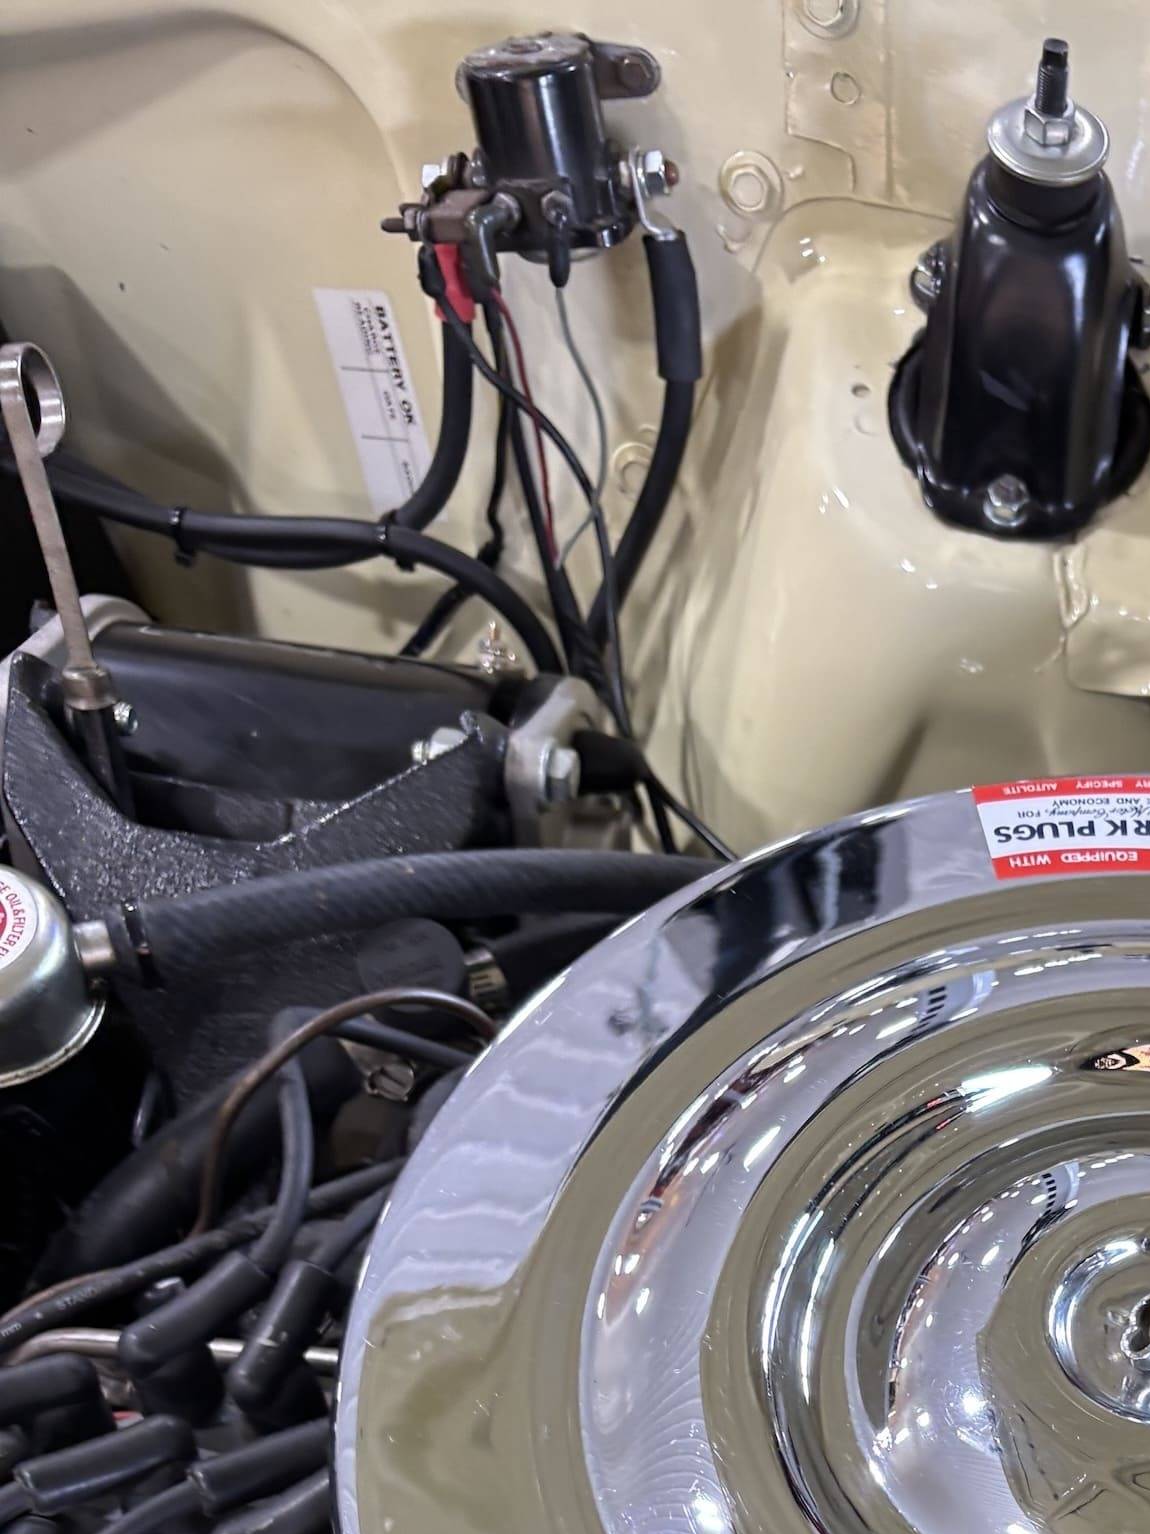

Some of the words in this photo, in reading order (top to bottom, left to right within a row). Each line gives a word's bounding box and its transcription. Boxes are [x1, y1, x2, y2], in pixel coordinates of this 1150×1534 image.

[375, 306, 406, 391] BATTERY
[399, 400, 416, 425] OK
[1003, 782, 1057, 795] AUTOLITE
[1075, 780, 1123, 789] SPECIFY
[1052, 797, 1110, 807] ECONOMY
[1116, 797, 1140, 805] AND
[993, 820, 1096, 843] PLUGS
[1009, 854, 1051, 868] WITH
[1060, 851, 1138, 863] EQUIPPED
